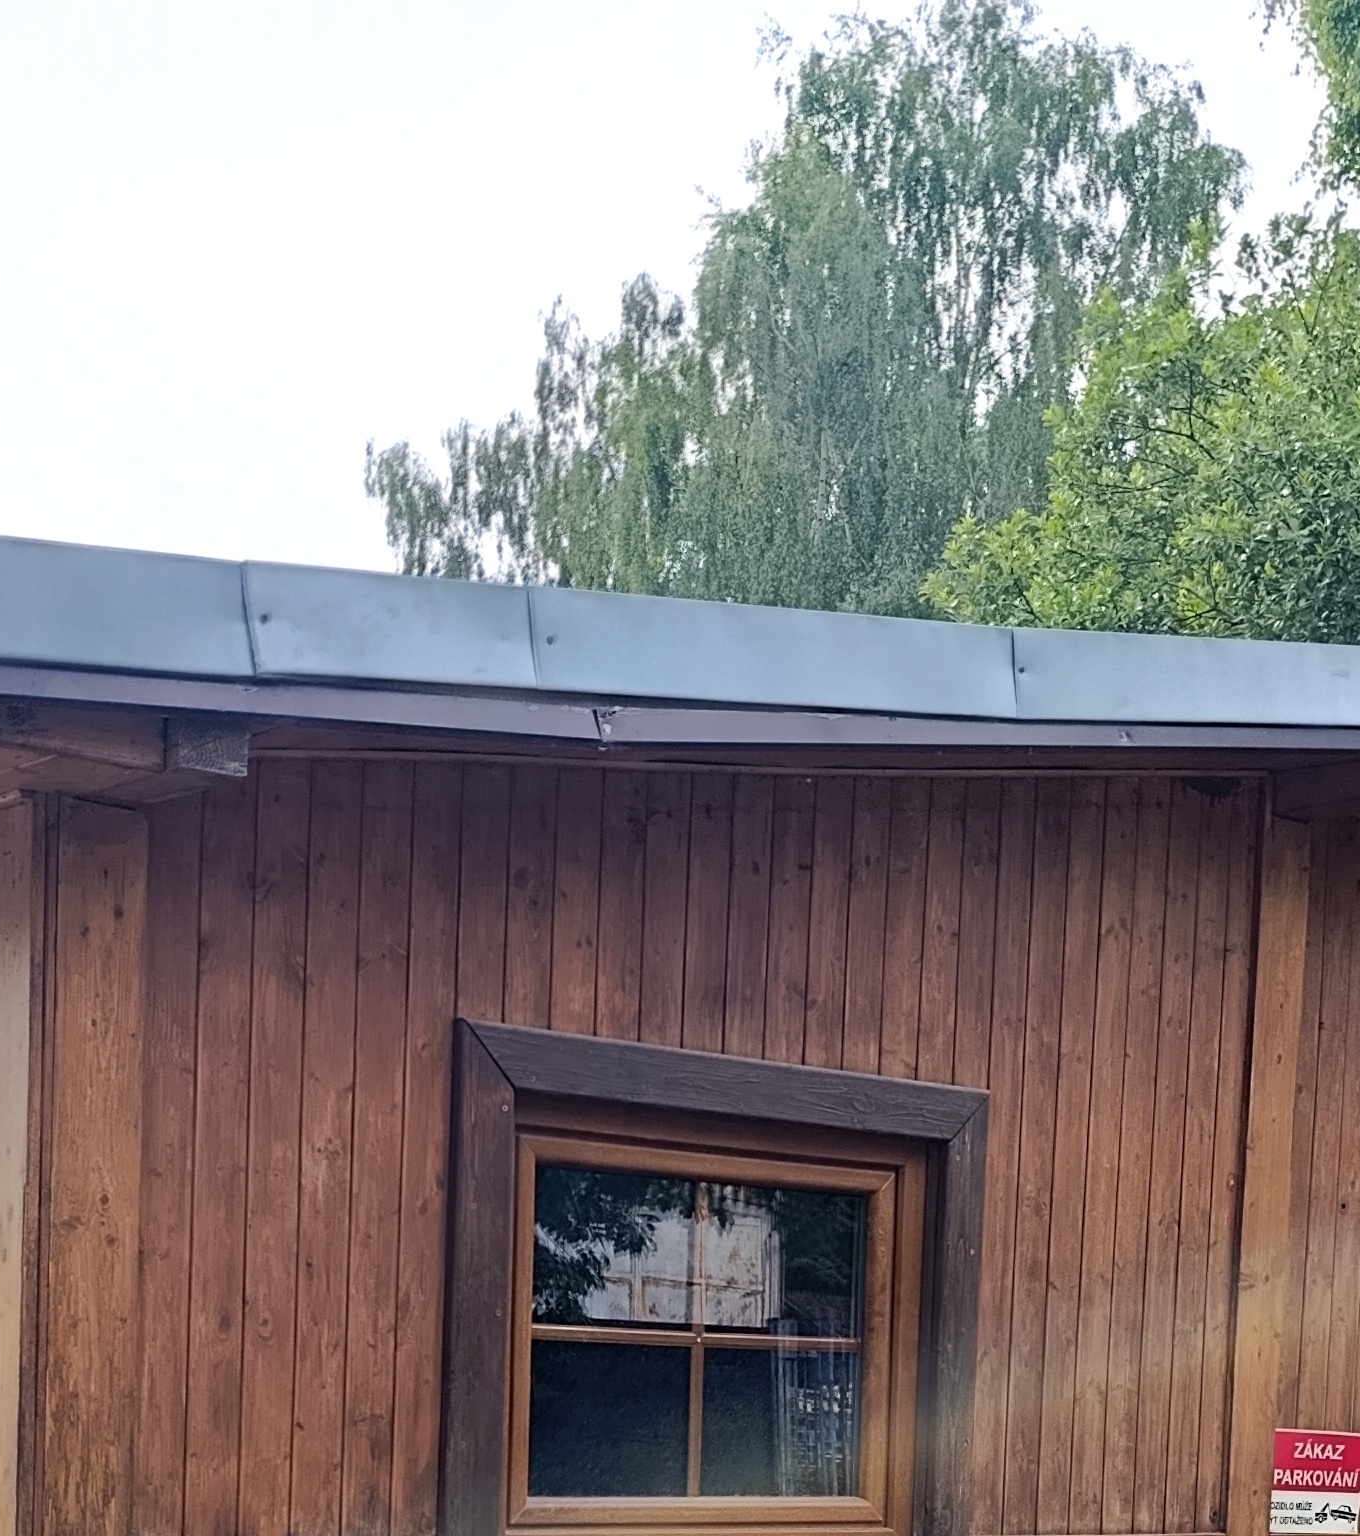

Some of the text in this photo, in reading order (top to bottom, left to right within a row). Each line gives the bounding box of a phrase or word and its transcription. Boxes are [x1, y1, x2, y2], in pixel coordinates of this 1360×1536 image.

[1293, 1439, 1346, 1461] ZÁKAZ
[1273, 1467, 1360, 1488] PARKOVÁNÍ
[1270, 1502, 1294, 1511] OZIDLO
